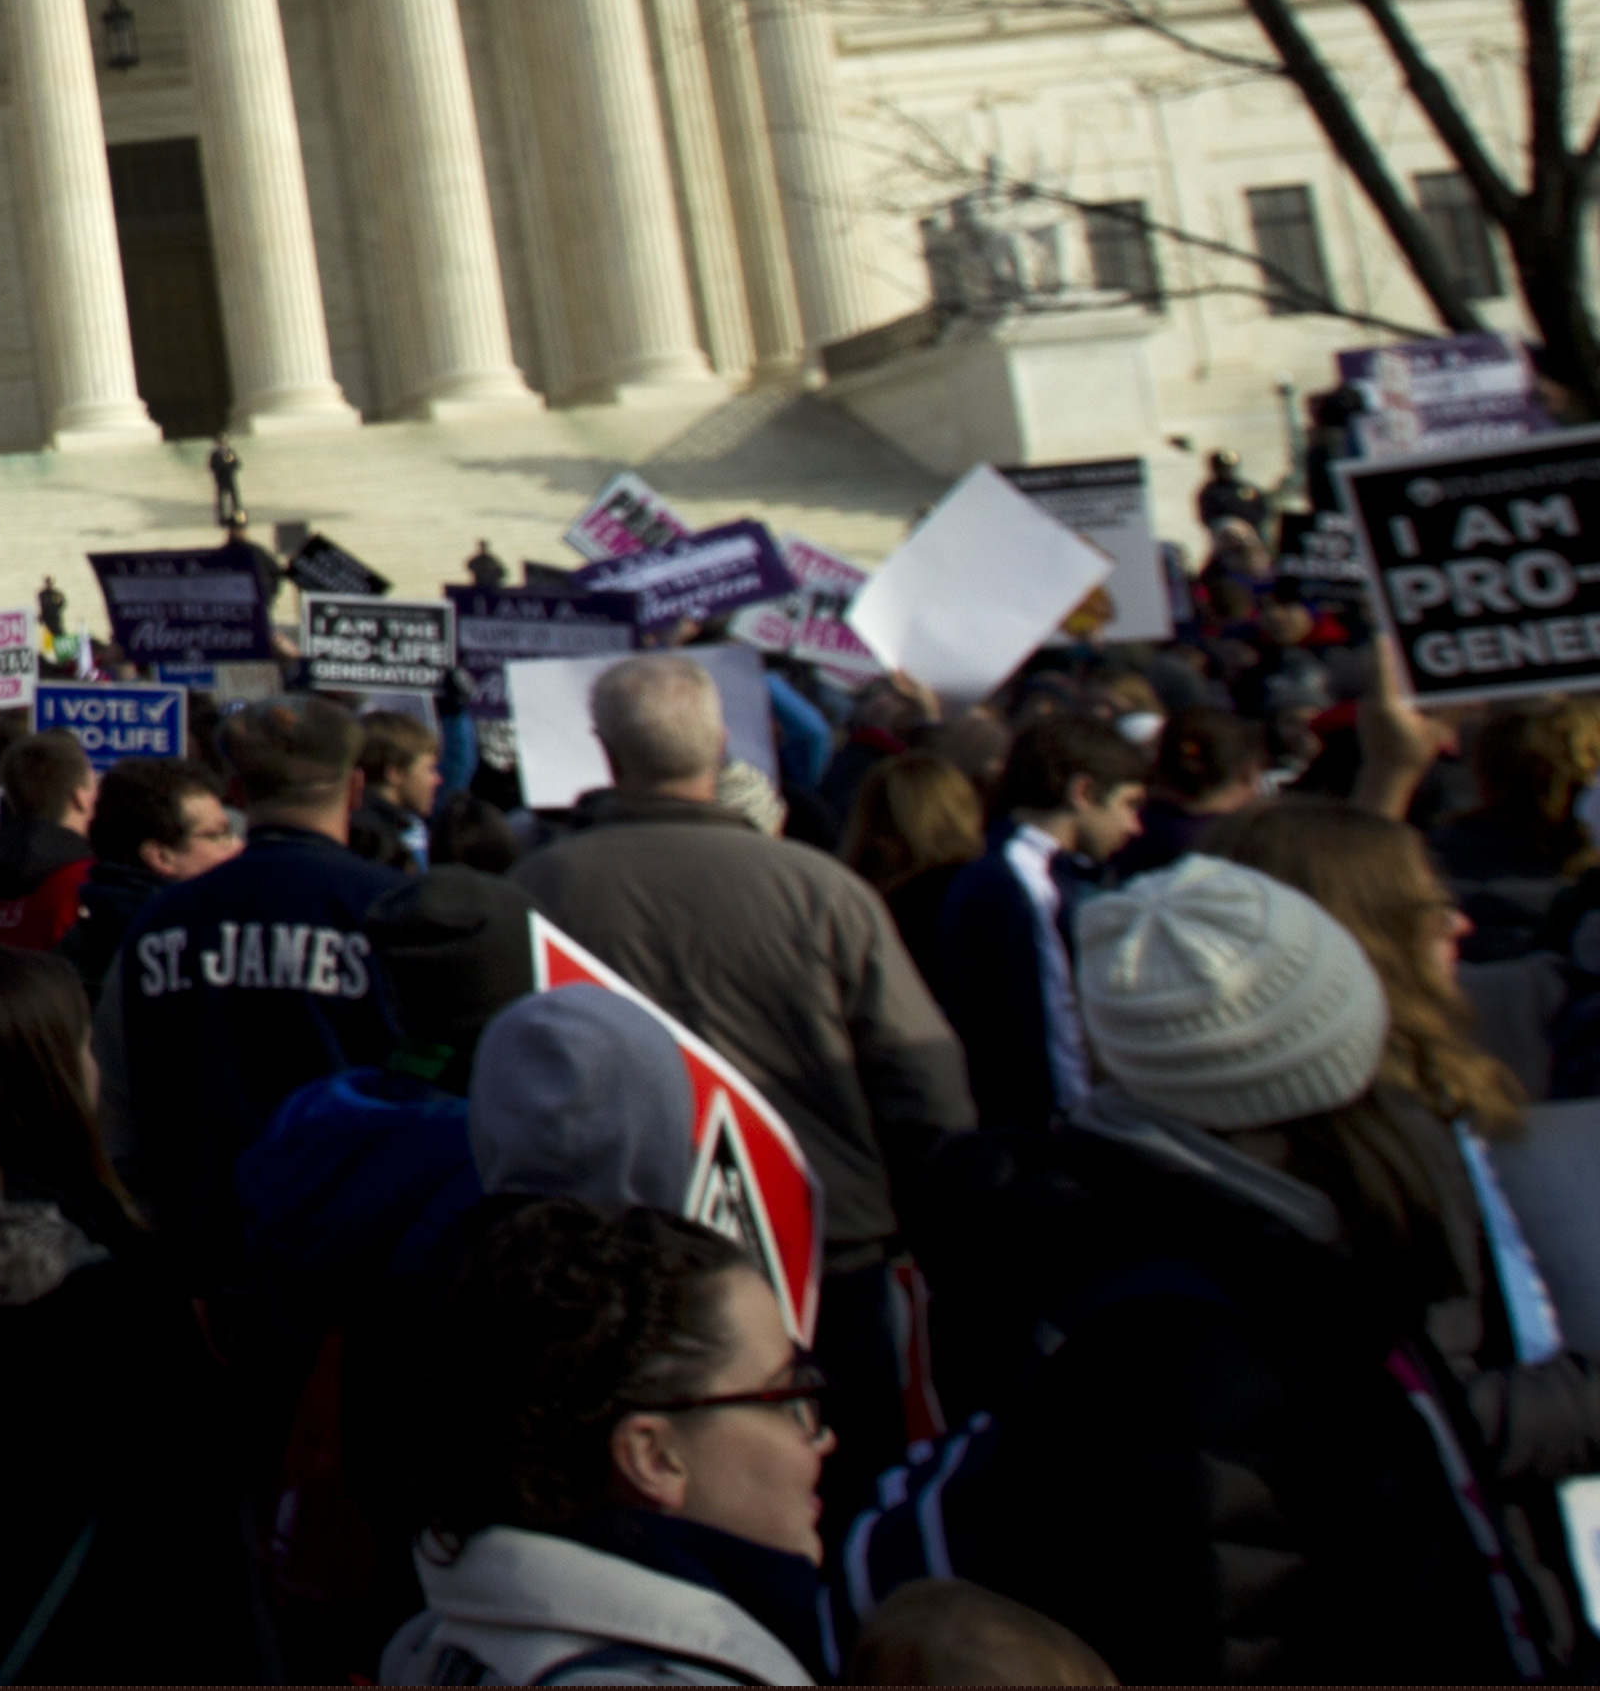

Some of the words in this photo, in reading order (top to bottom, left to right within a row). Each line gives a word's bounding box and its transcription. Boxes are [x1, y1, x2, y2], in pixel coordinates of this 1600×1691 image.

[1387, 514, 1422, 558] I
[1451, 492, 1582, 551] AM
[129, 619, 255, 651] Abortion
[313, 616, 327, 635] I
[334, 617, 378, 636] AM
[387, 619, 440, 639] THE
[312, 635, 450, 666] PRO-LIFE
[311, 659, 444, 685] GENERATION
[43, 697, 56, 721] I
[60, 697, 140, 723] VOTE
[68, 725, 171, 753] O-LIFE
[136, 925, 194, 998] ST.
[198, 919, 372, 1000] JAMES
